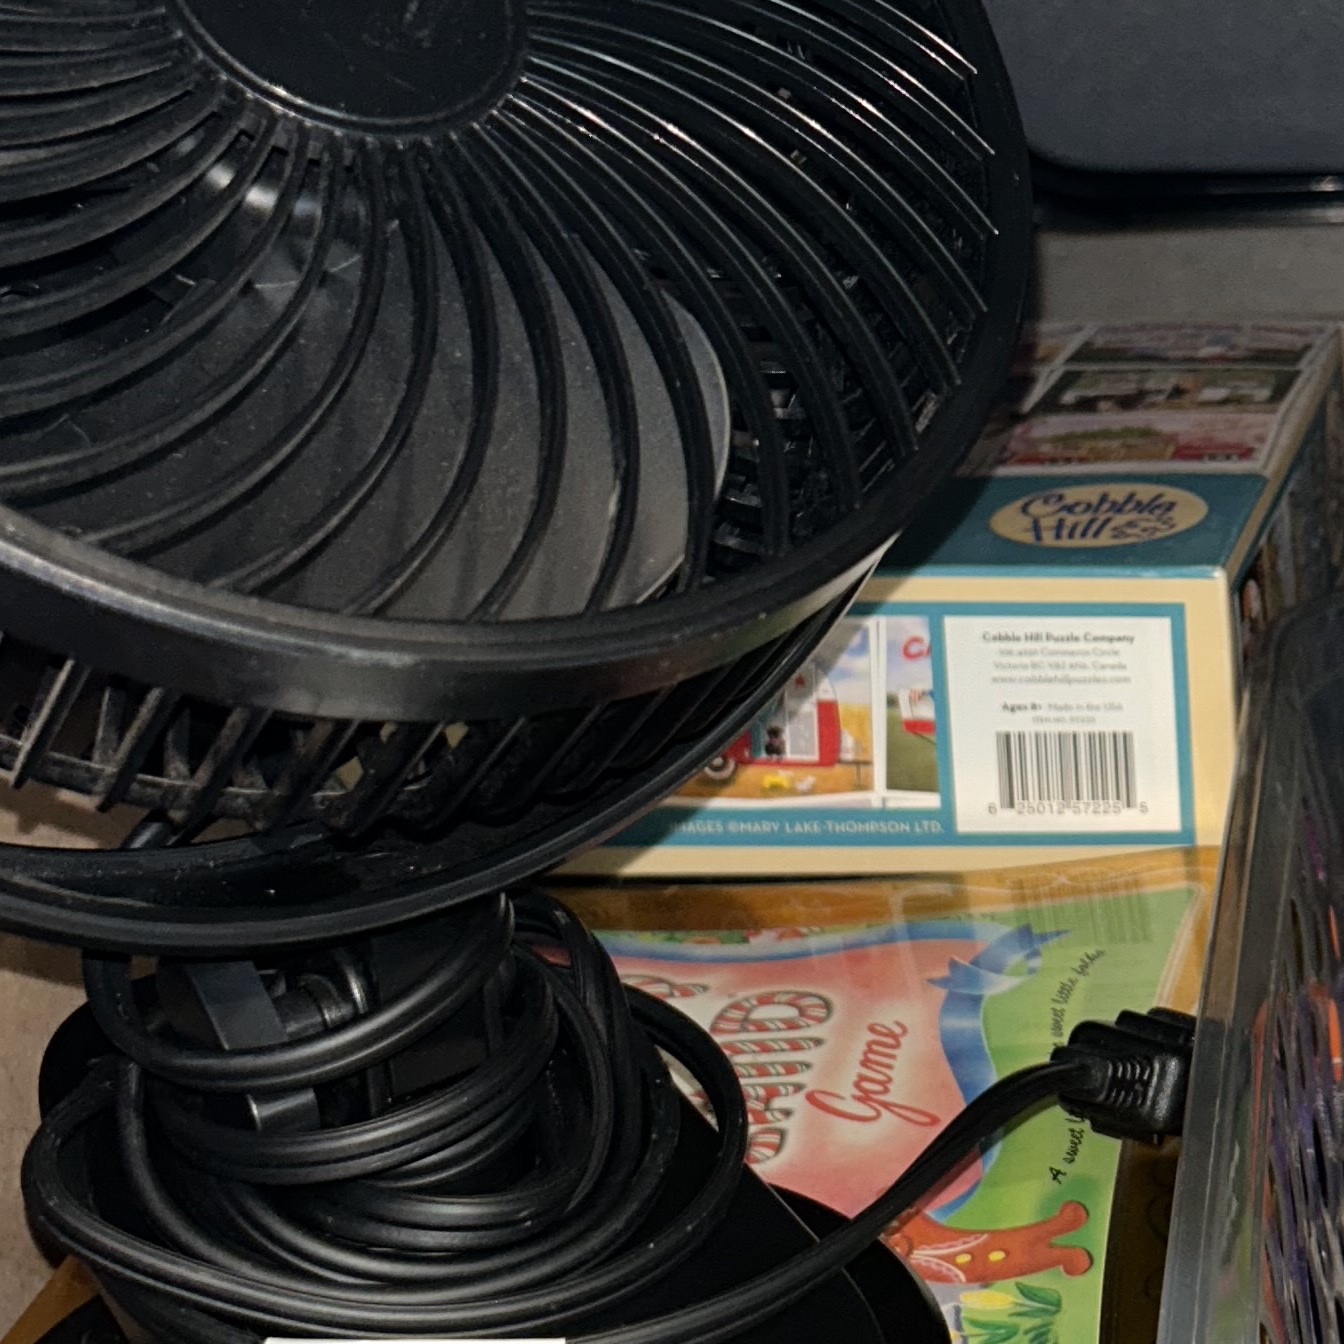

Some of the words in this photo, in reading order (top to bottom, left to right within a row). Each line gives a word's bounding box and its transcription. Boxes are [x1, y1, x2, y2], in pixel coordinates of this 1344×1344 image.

[1020, 492, 1177, 523] Cobble
[1025, 516, 1110, 544] Hill
[1083, 632, 1135, 645] Company
[988, 802, 998, 815] 6
[1139, 802, 1149, 815] 5
[805, 1018, 941, 1127] Game
